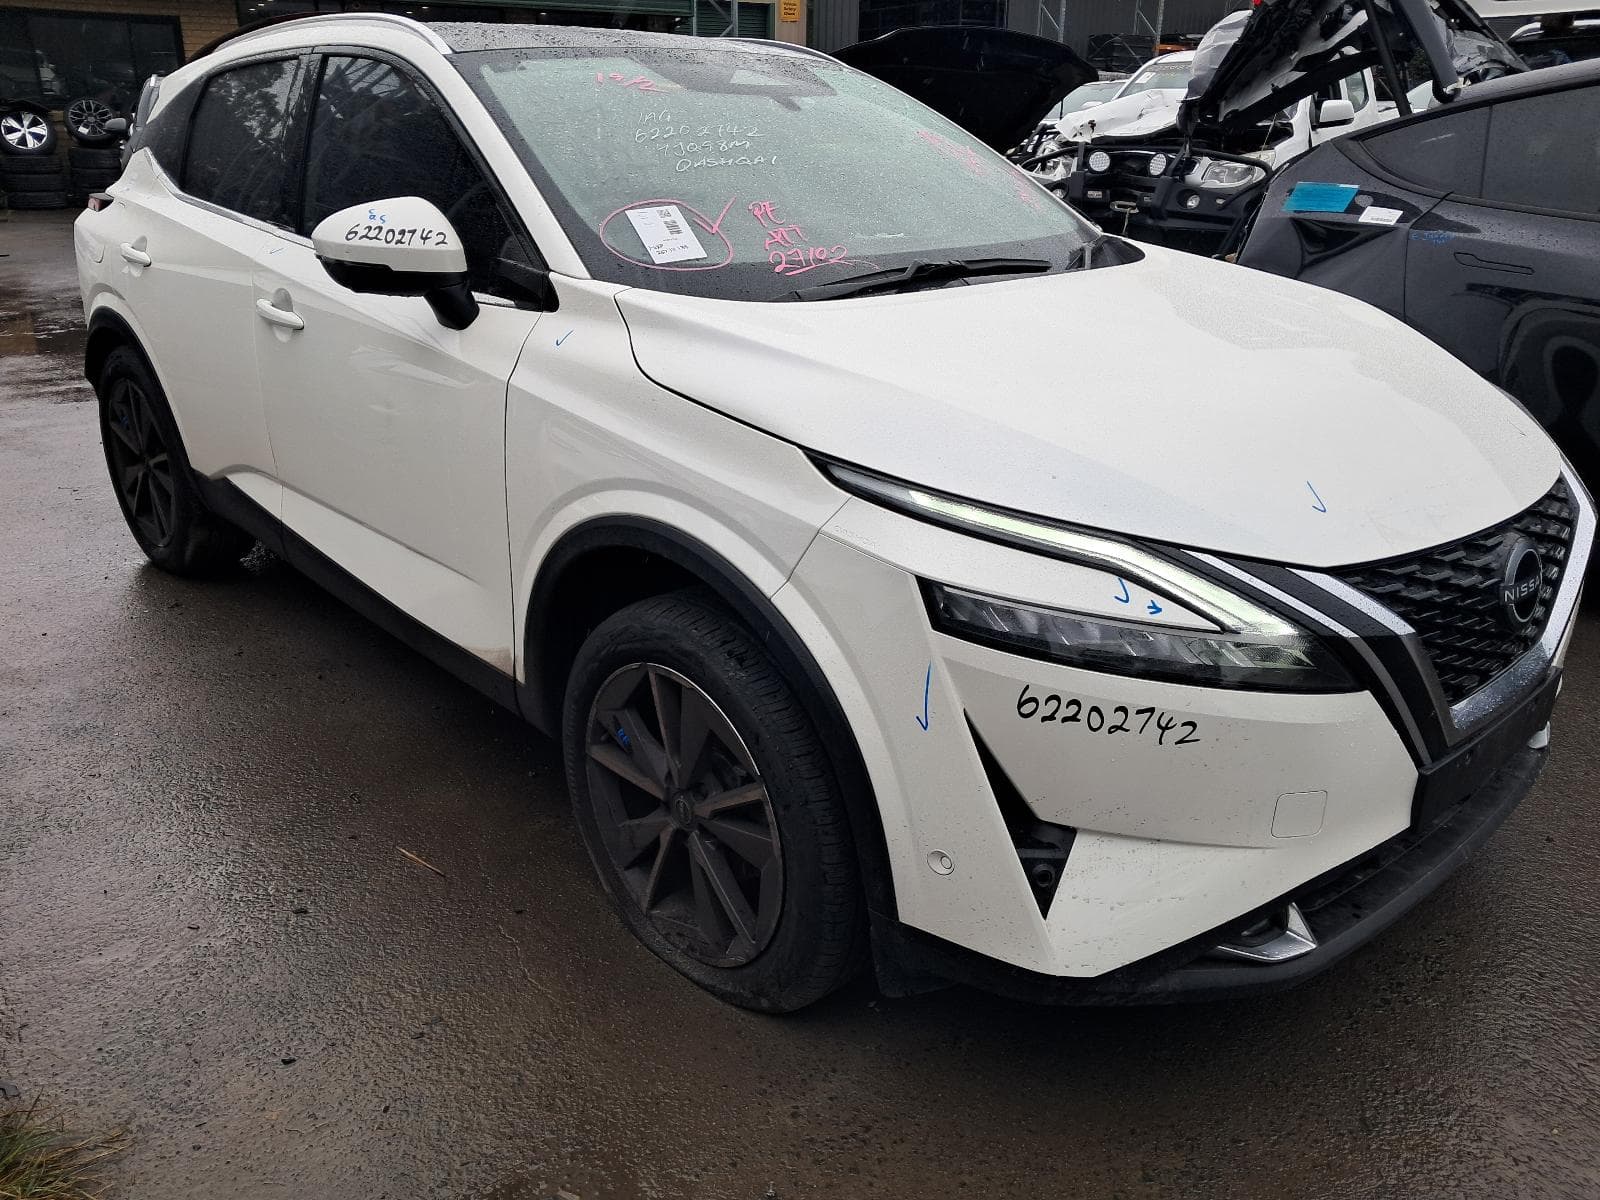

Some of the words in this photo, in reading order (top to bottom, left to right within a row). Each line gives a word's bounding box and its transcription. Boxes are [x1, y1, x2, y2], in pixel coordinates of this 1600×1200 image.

[344, 223, 448, 246] 62202742
[1504, 575, 1540, 602] NISSA
[1016, 684, 1201, 746] 62202742
